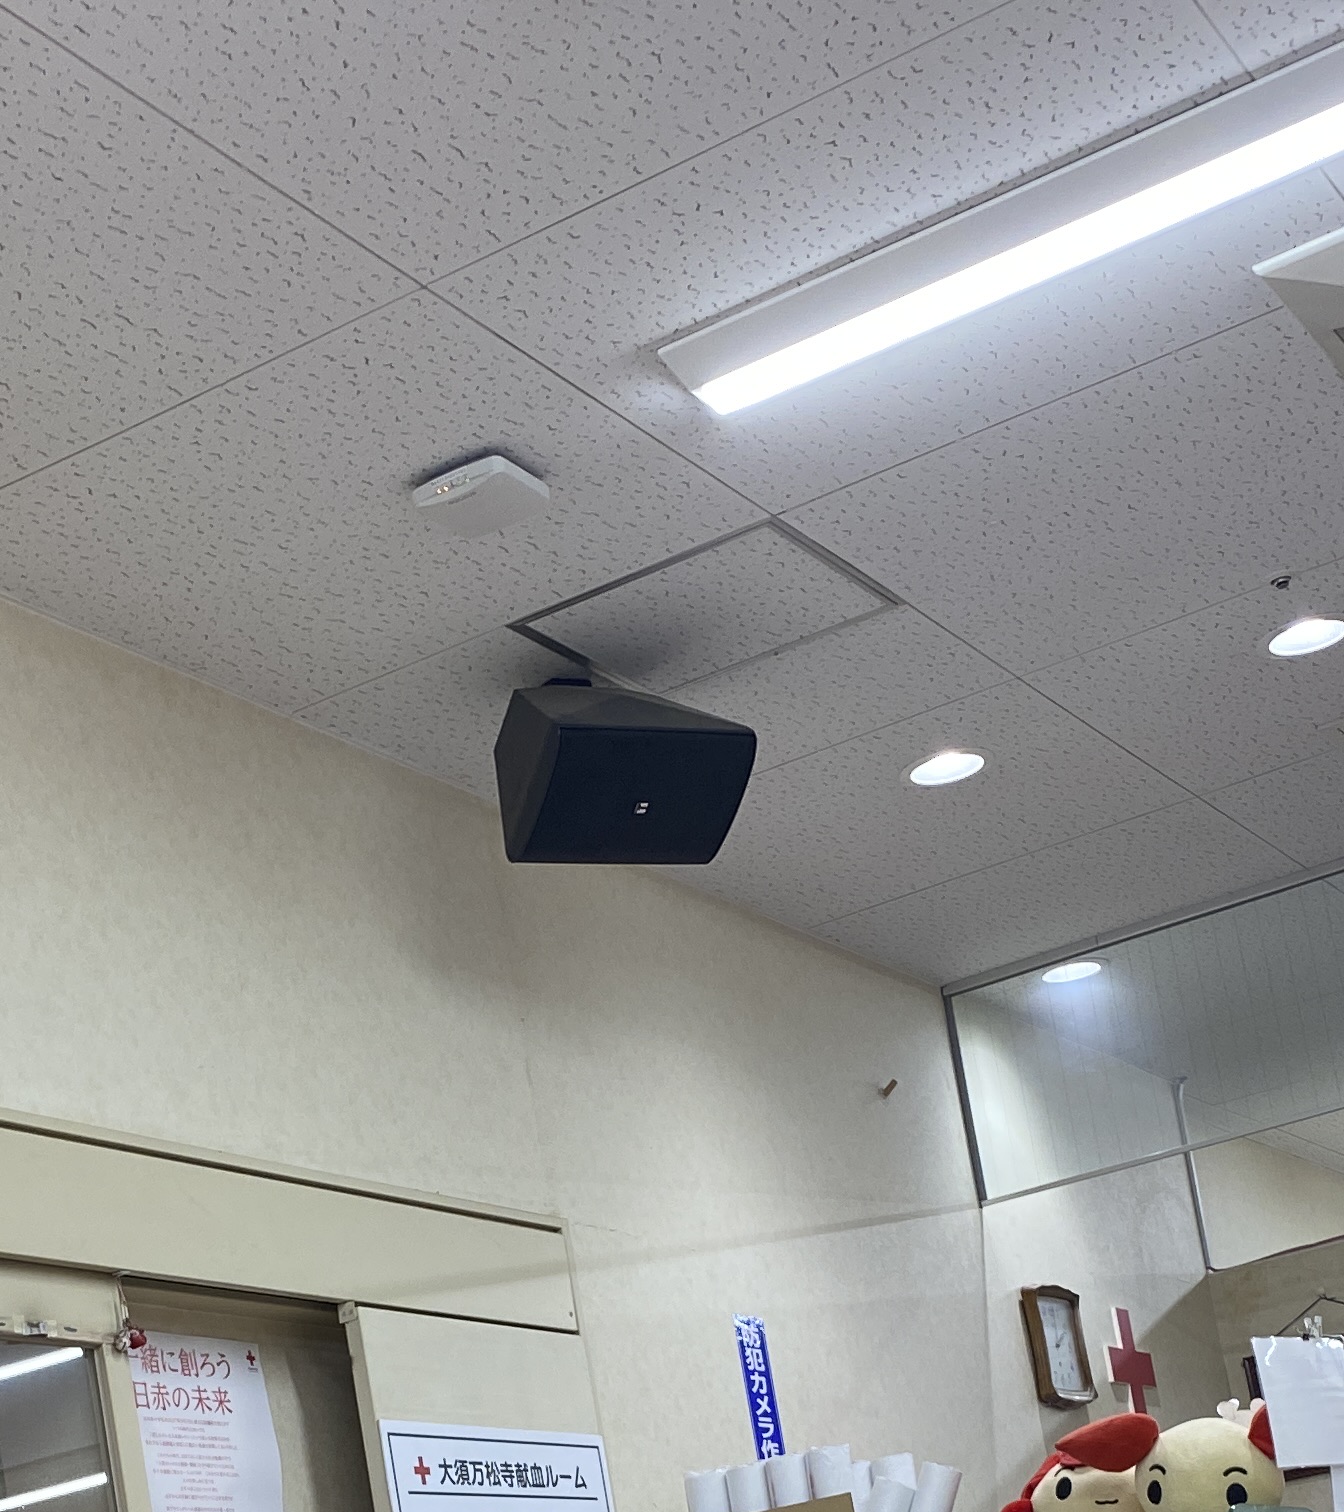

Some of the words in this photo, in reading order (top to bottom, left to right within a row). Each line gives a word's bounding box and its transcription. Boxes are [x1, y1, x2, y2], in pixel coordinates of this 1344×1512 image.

[133, 1381, 233, 1415] 日赤の未来
[439, 1457, 587, 1489] 大須万松寺献血ルーム
